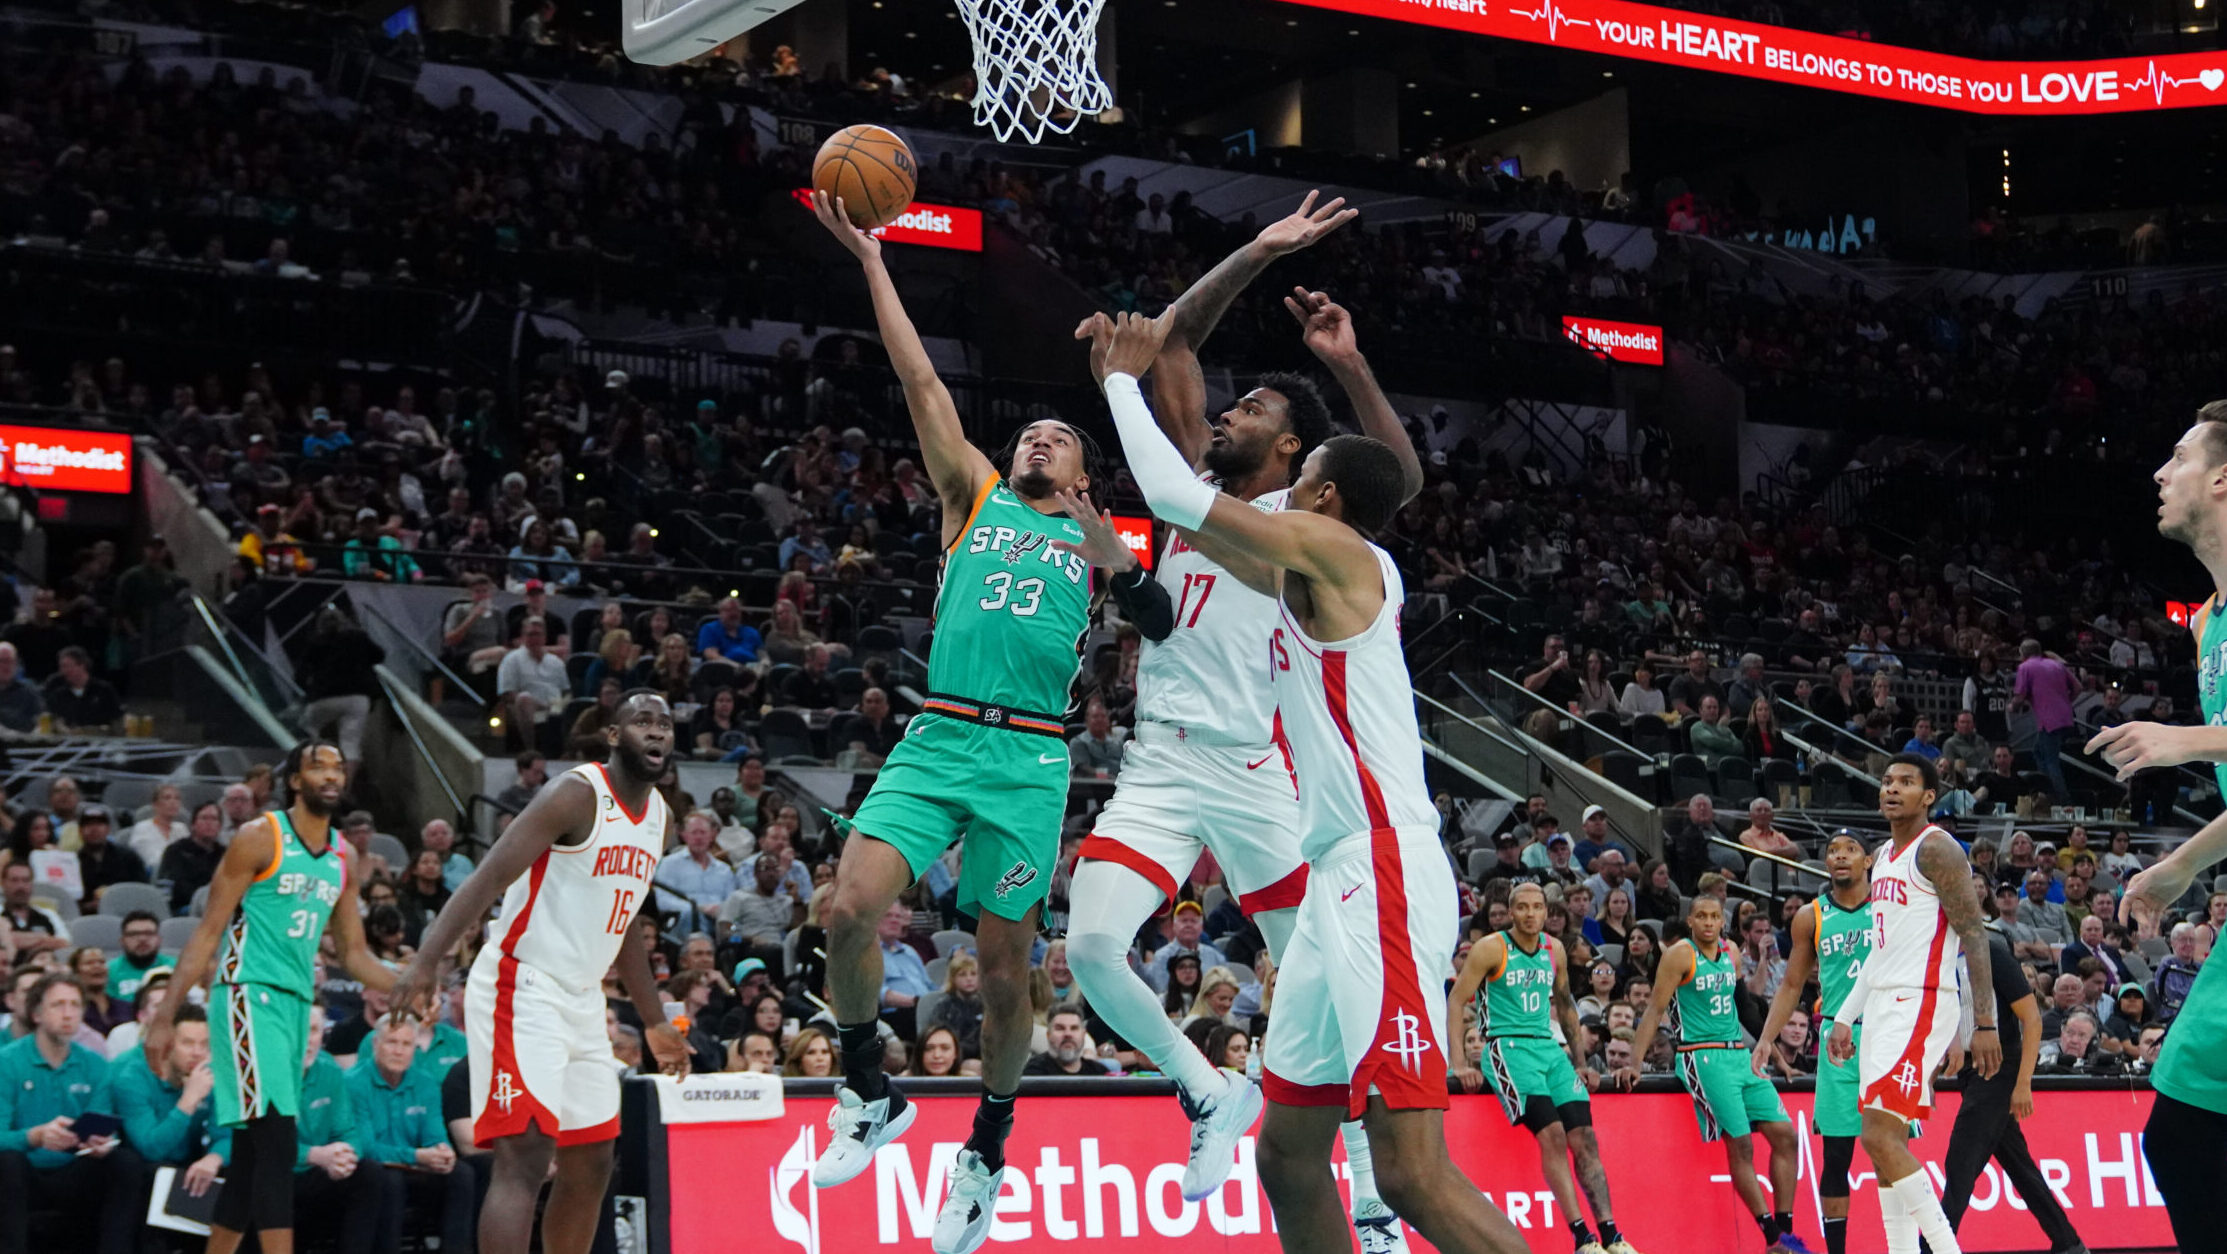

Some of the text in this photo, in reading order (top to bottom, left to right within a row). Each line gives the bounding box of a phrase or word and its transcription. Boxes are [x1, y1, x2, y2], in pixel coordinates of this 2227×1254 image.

[1595, 19, 2119, 103] YOUR HEART BELONGS TO THOSE YOU LOVE
[780, 122, 816, 145] 108
[2091, 277, 2127, 297] 110
[1587, 327, 1658, 351] Methodist
[15, 442, 125, 471] Methodist
[978, 570, 1047, 616] 33
[1173, 572, 1217, 628] 17
[1989, 697, 2005, 712] 20
[606, 888, 634, 935] 16
[287, 909, 318, 939] 31
[1520, 991, 1540, 1013] 10
[1710, 994, 1732, 1016] 35
[682, 1088, 761, 1101] GATORADE
